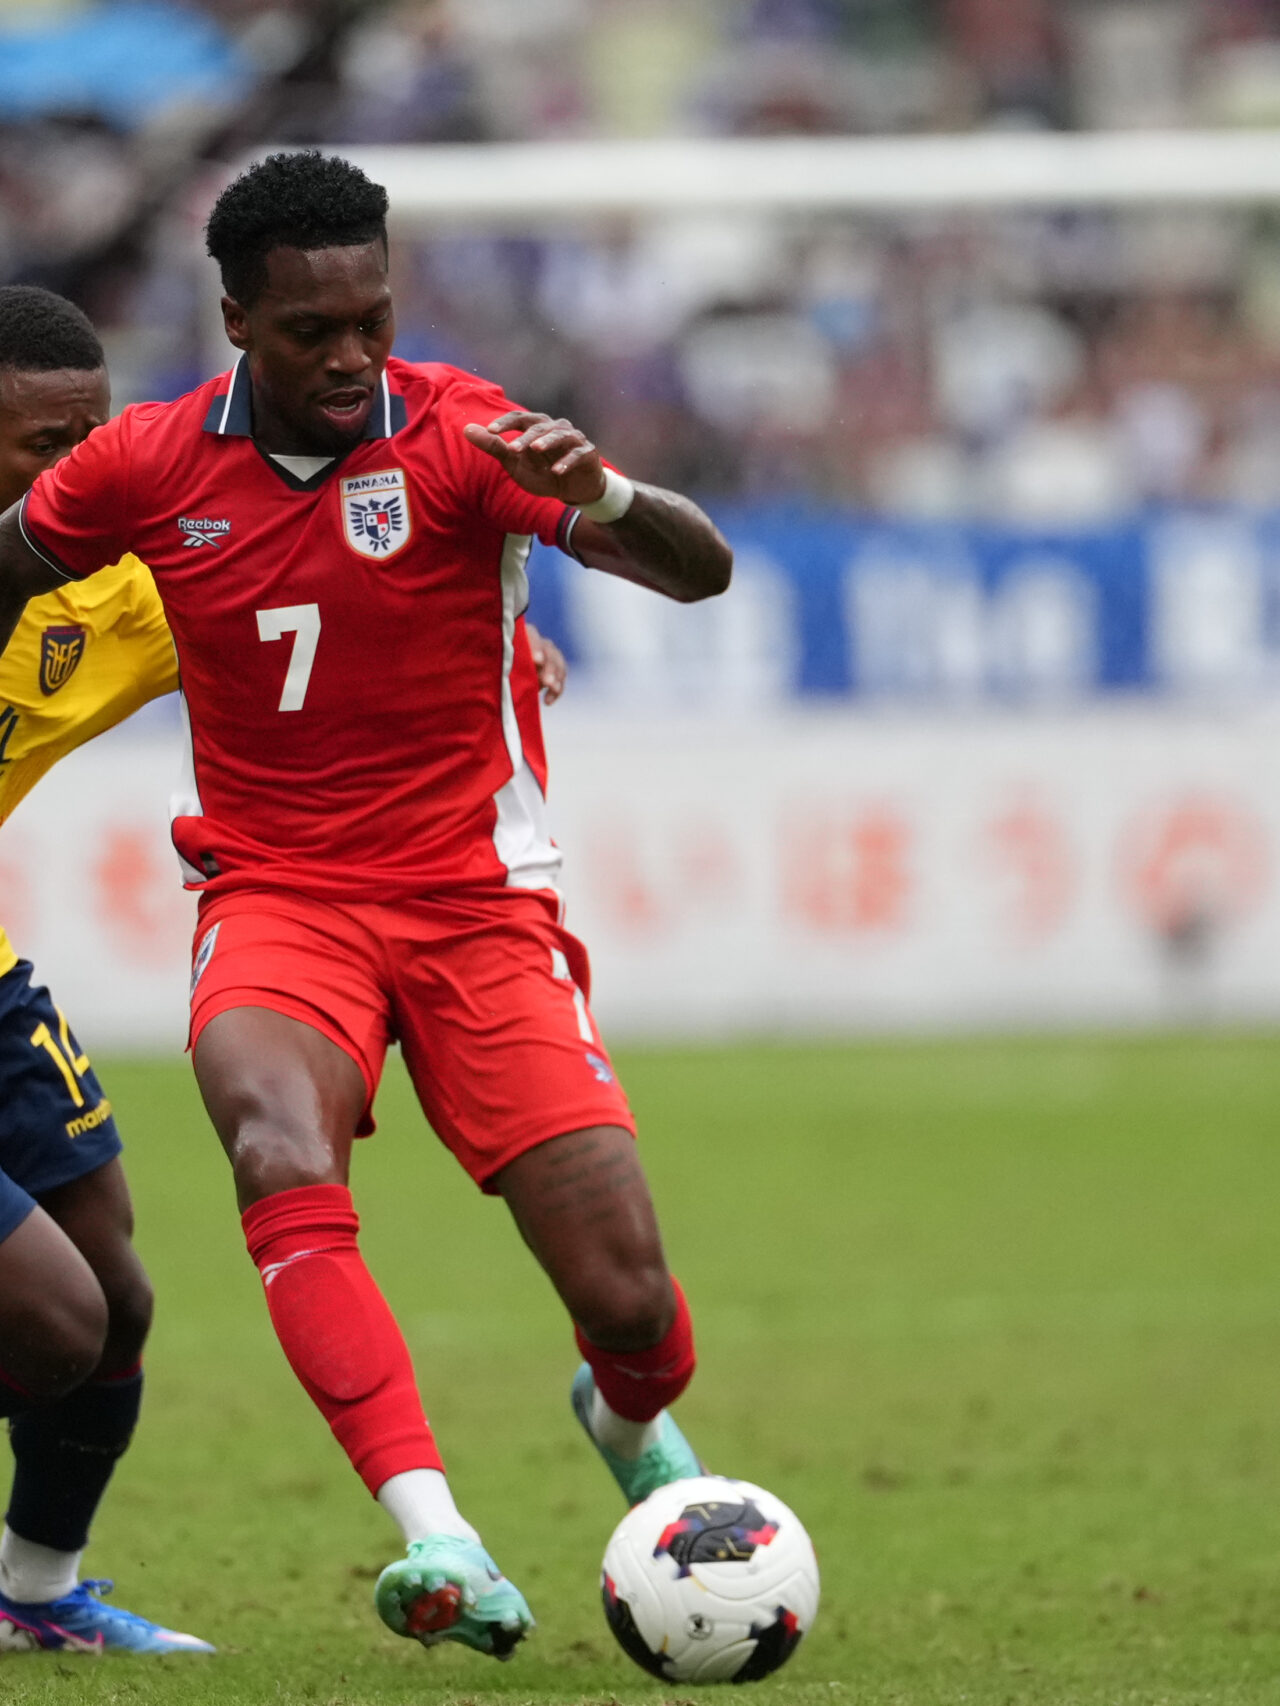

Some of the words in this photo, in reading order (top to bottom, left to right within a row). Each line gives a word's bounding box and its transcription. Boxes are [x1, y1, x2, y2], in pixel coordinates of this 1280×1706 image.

[346, 473, 400, 492] PANAMA
[177, 516, 232, 532] Reebok
[255, 602, 322, 712] 7
